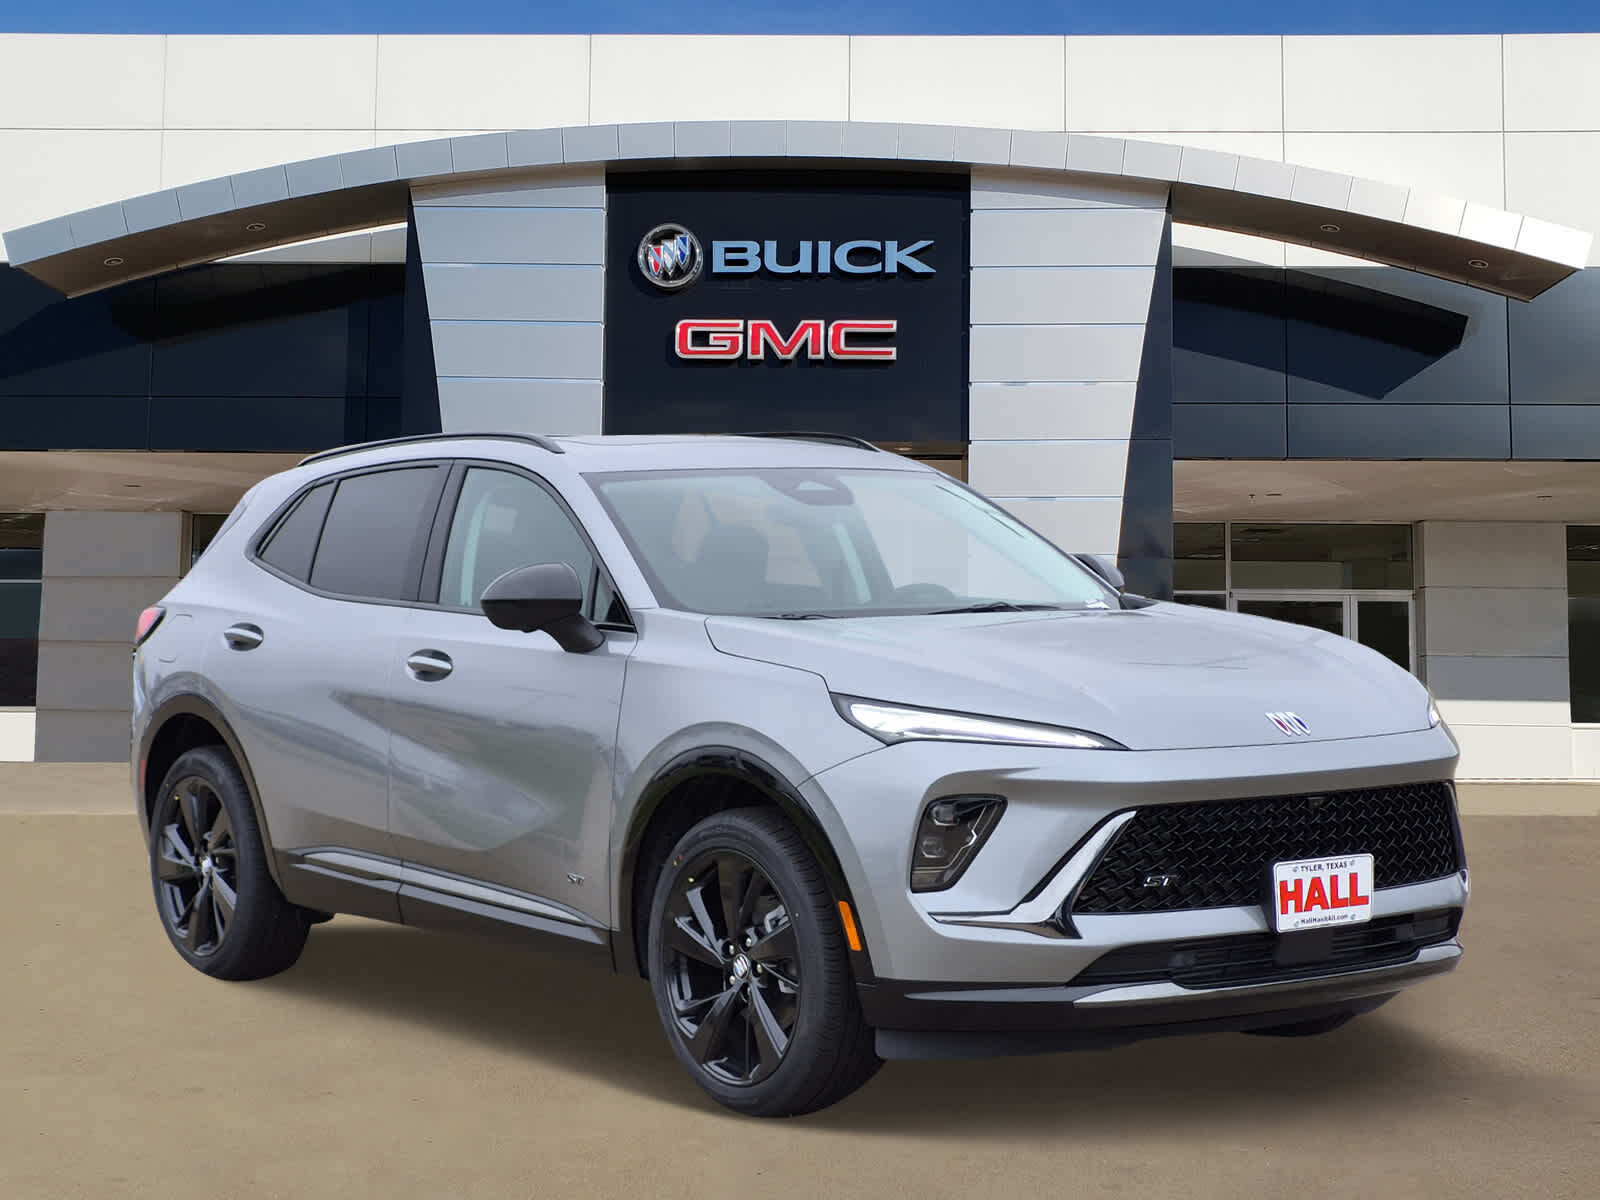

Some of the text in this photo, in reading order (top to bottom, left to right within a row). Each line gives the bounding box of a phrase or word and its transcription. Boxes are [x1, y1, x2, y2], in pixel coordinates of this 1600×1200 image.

[711, 240, 937, 274] BUICK
[674, 318, 898, 361] GMC
[1143, 873, 1177, 887] ST
[1300, 861, 1347, 872] TYLER, TEXAS
[1279, 872, 1369, 915] HALL
